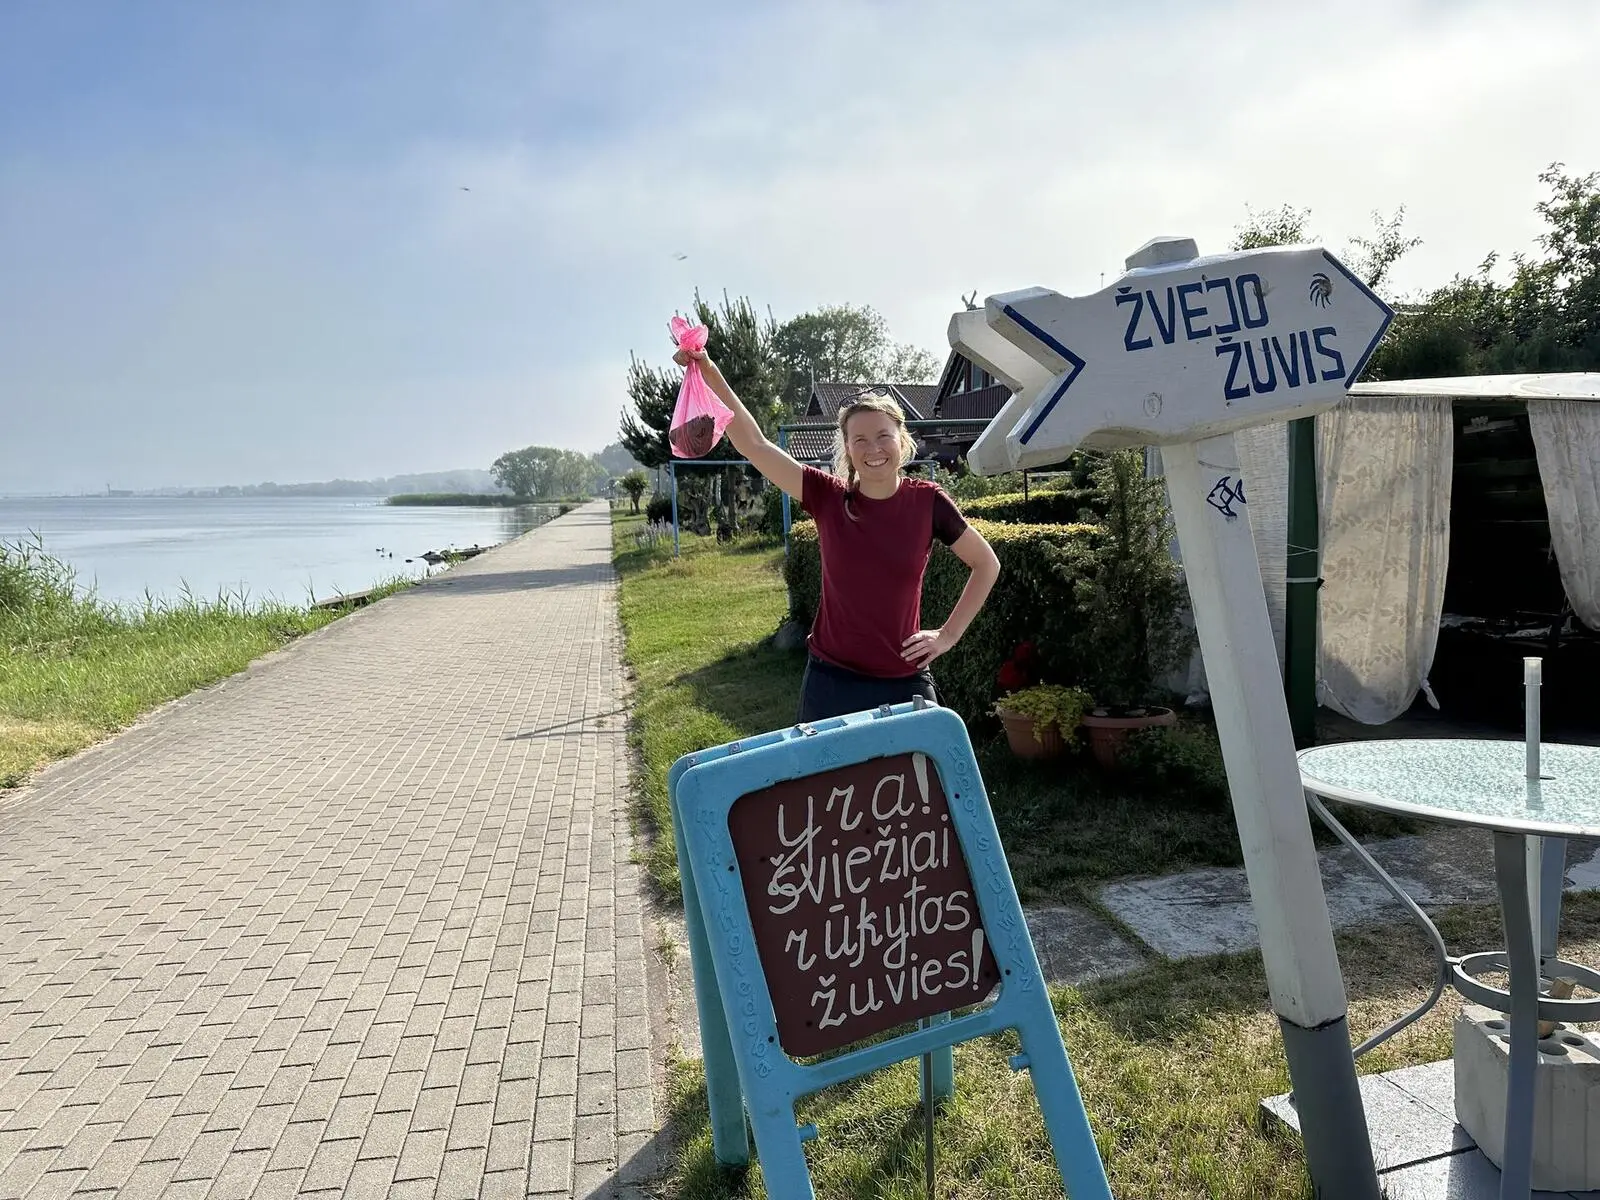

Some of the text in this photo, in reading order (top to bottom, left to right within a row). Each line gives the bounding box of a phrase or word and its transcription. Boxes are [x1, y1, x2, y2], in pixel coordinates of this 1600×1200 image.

[1115, 273, 1268, 351] ŽVEJO
[1215, 326, 1346, 400] ŽUVIS
[785, 877, 971, 970] rūkytos
[811, 928, 984, 1029] žuvies!
